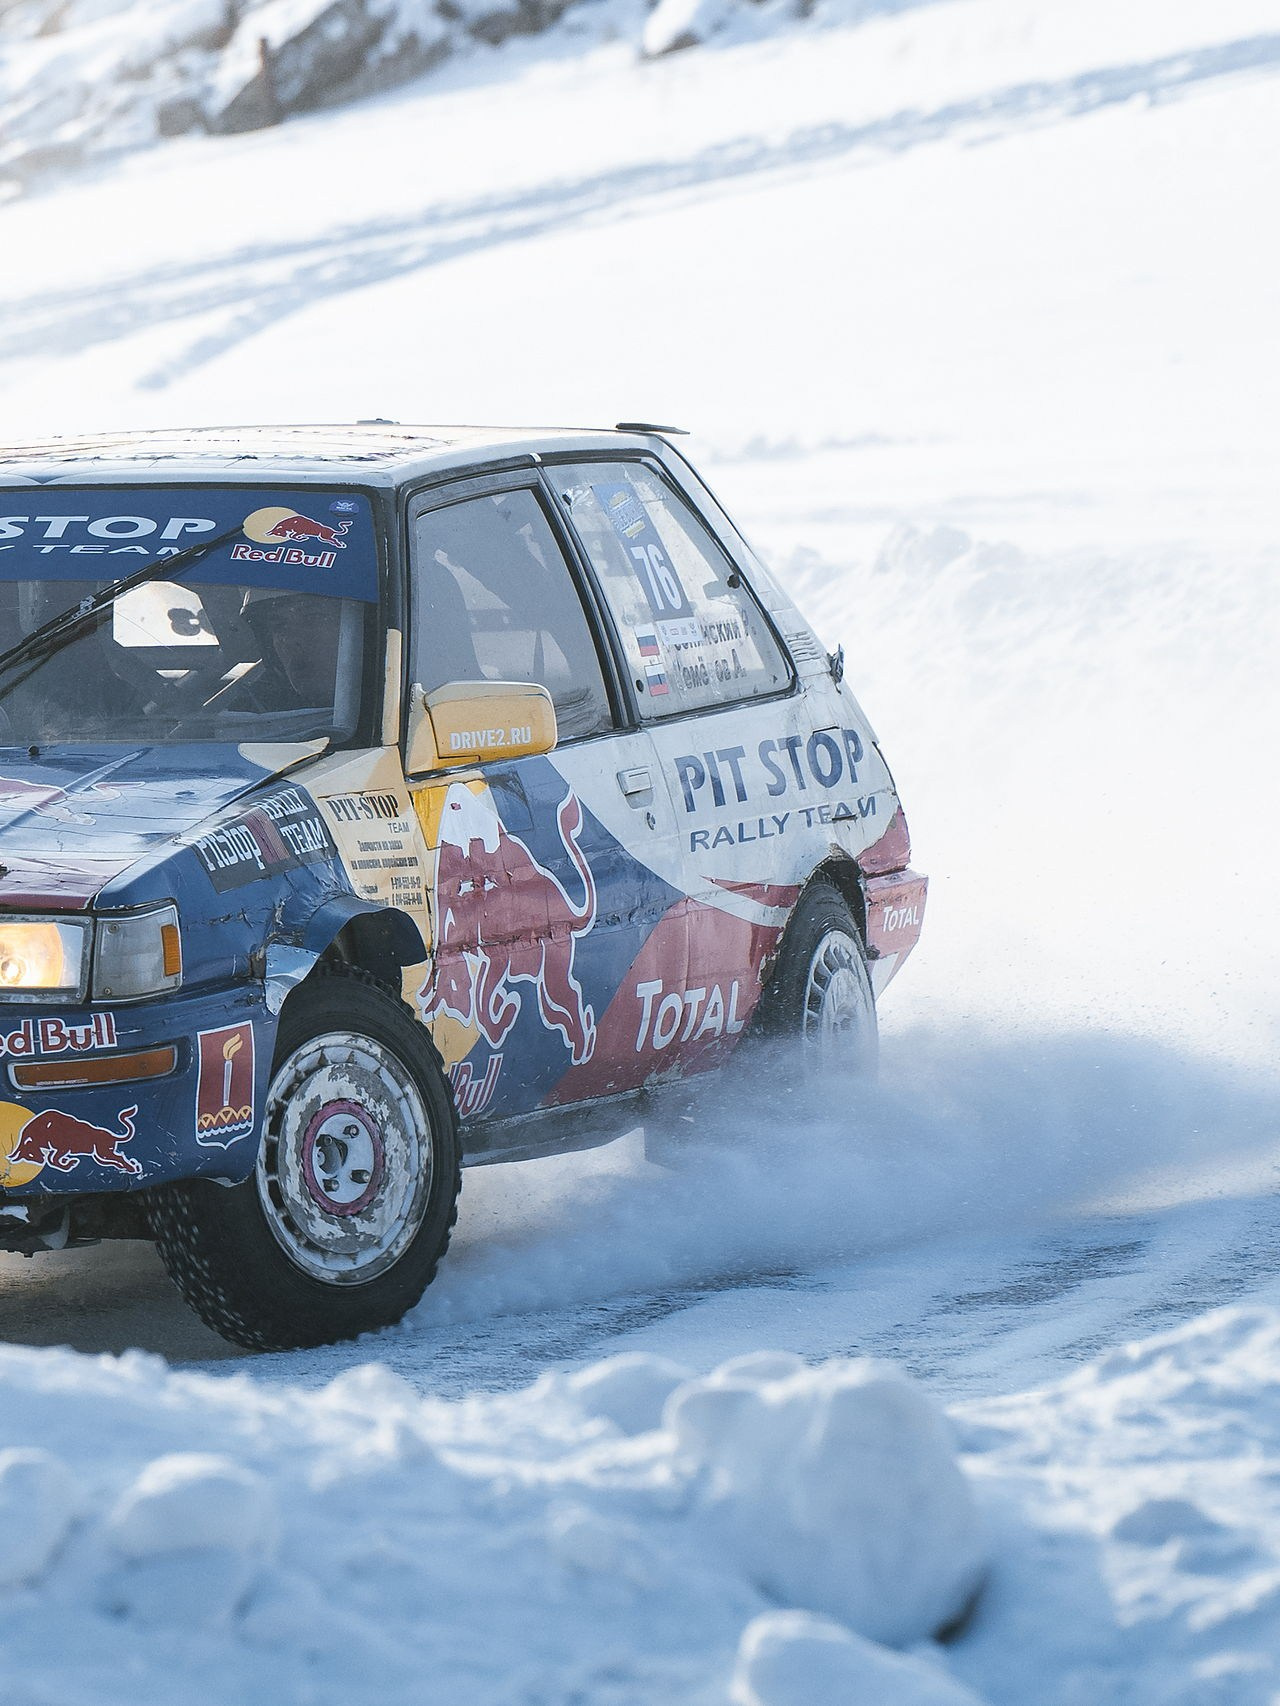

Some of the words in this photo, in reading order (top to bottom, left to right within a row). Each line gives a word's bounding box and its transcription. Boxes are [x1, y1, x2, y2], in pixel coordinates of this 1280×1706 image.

[230, 544, 285, 563] Red
[284, 549, 337, 568] Bull
[630, 544, 682, 610] 76
[450, 726, 532, 750] DRIVE2.RU
[674, 745, 748, 812] PIT
[758, 729, 864, 797] STOP
[326, 795, 399, 822] PIT-STOP
[281, 818, 329, 855] TEAM
[388, 822, 411, 834] TEAM
[690, 812, 790, 852] RALLY
[38, 1012, 118, 1053] Bull
